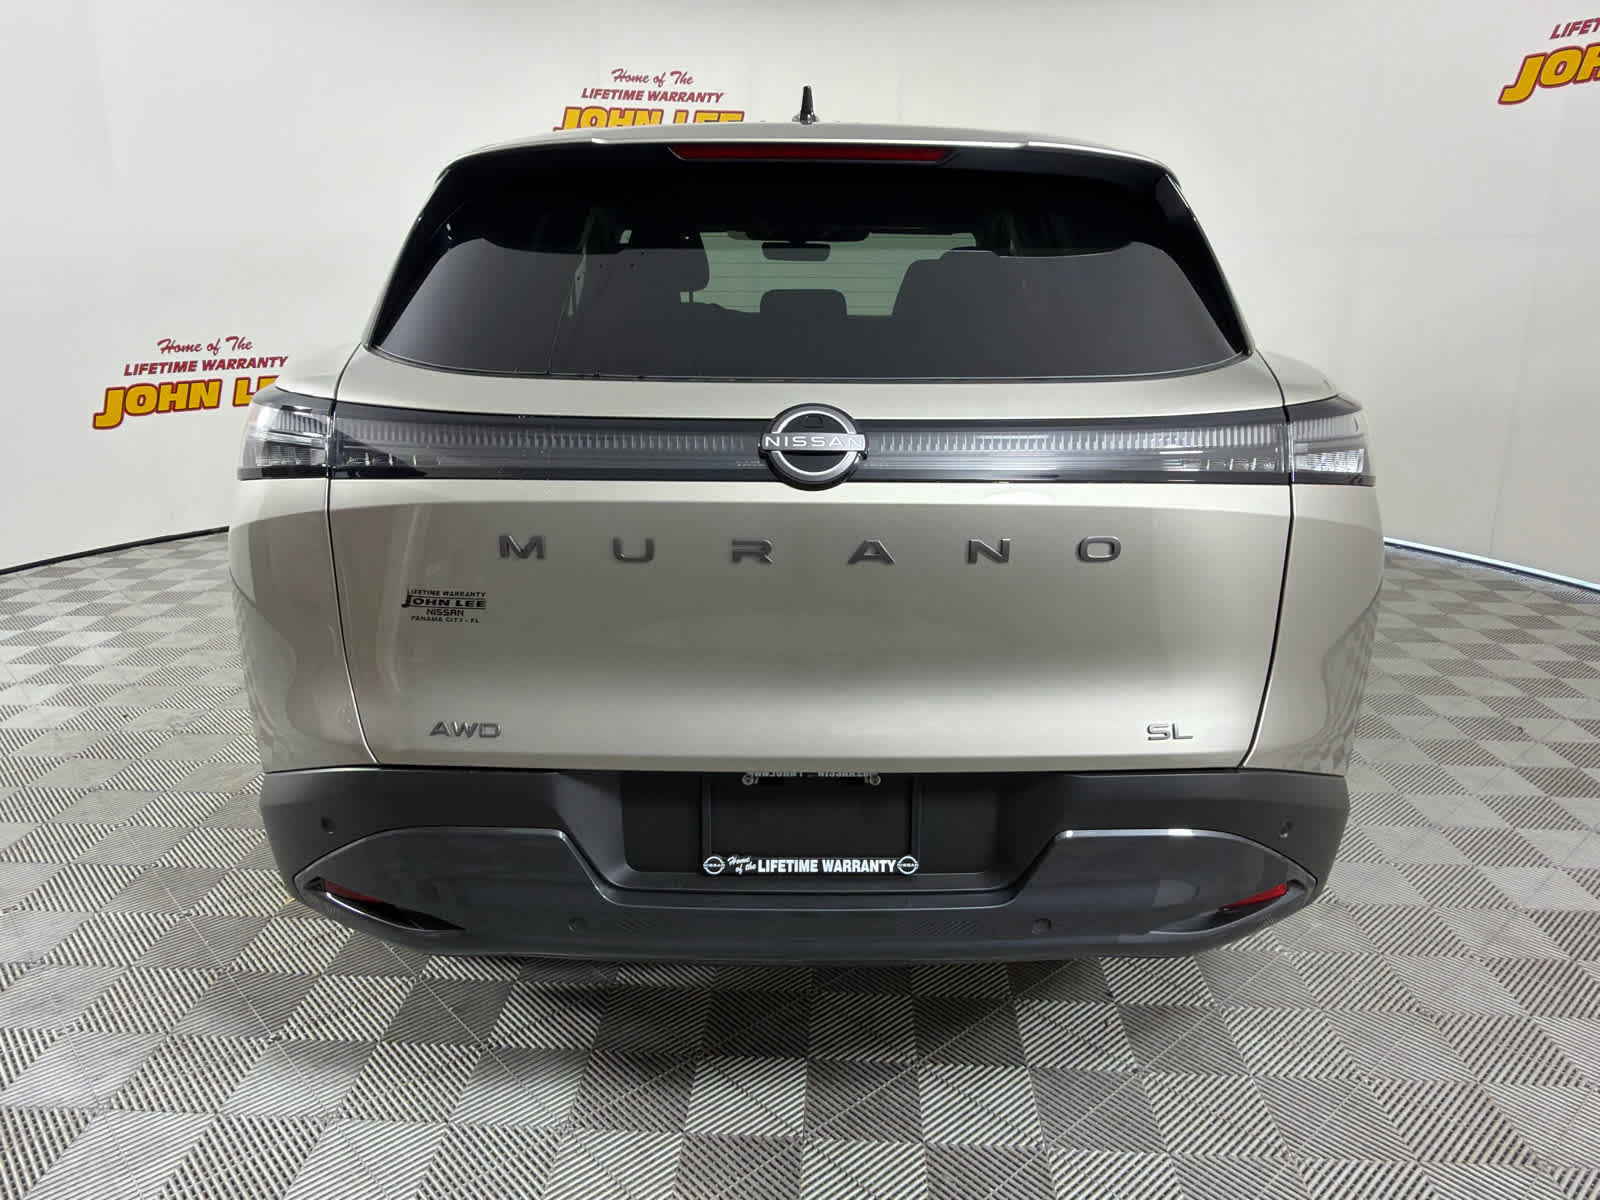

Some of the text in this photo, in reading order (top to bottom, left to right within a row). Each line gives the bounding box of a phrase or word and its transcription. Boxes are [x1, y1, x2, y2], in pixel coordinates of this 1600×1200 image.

[611, 68, 694, 87] Home of The
[581, 88, 724, 103] LIFETIME WARRANTY
[157, 336, 253, 356] Home of The
[124, 356, 288, 376] LIFETIME WARRANTY
[93, 379, 223, 430] JOHN
[765, 436, 863, 447] NISSAN
[499, 535, 1122, 563] MURANO
[401, 587, 486, 608] JOHN LEE
[426, 608, 464, 616] NISSAN
[430, 721, 501, 738] AWD
[1147, 723, 1194, 740] SL
[728, 856, 751, 866] Home
[758, 859, 896, 873] LIFETIME WARRANTY
